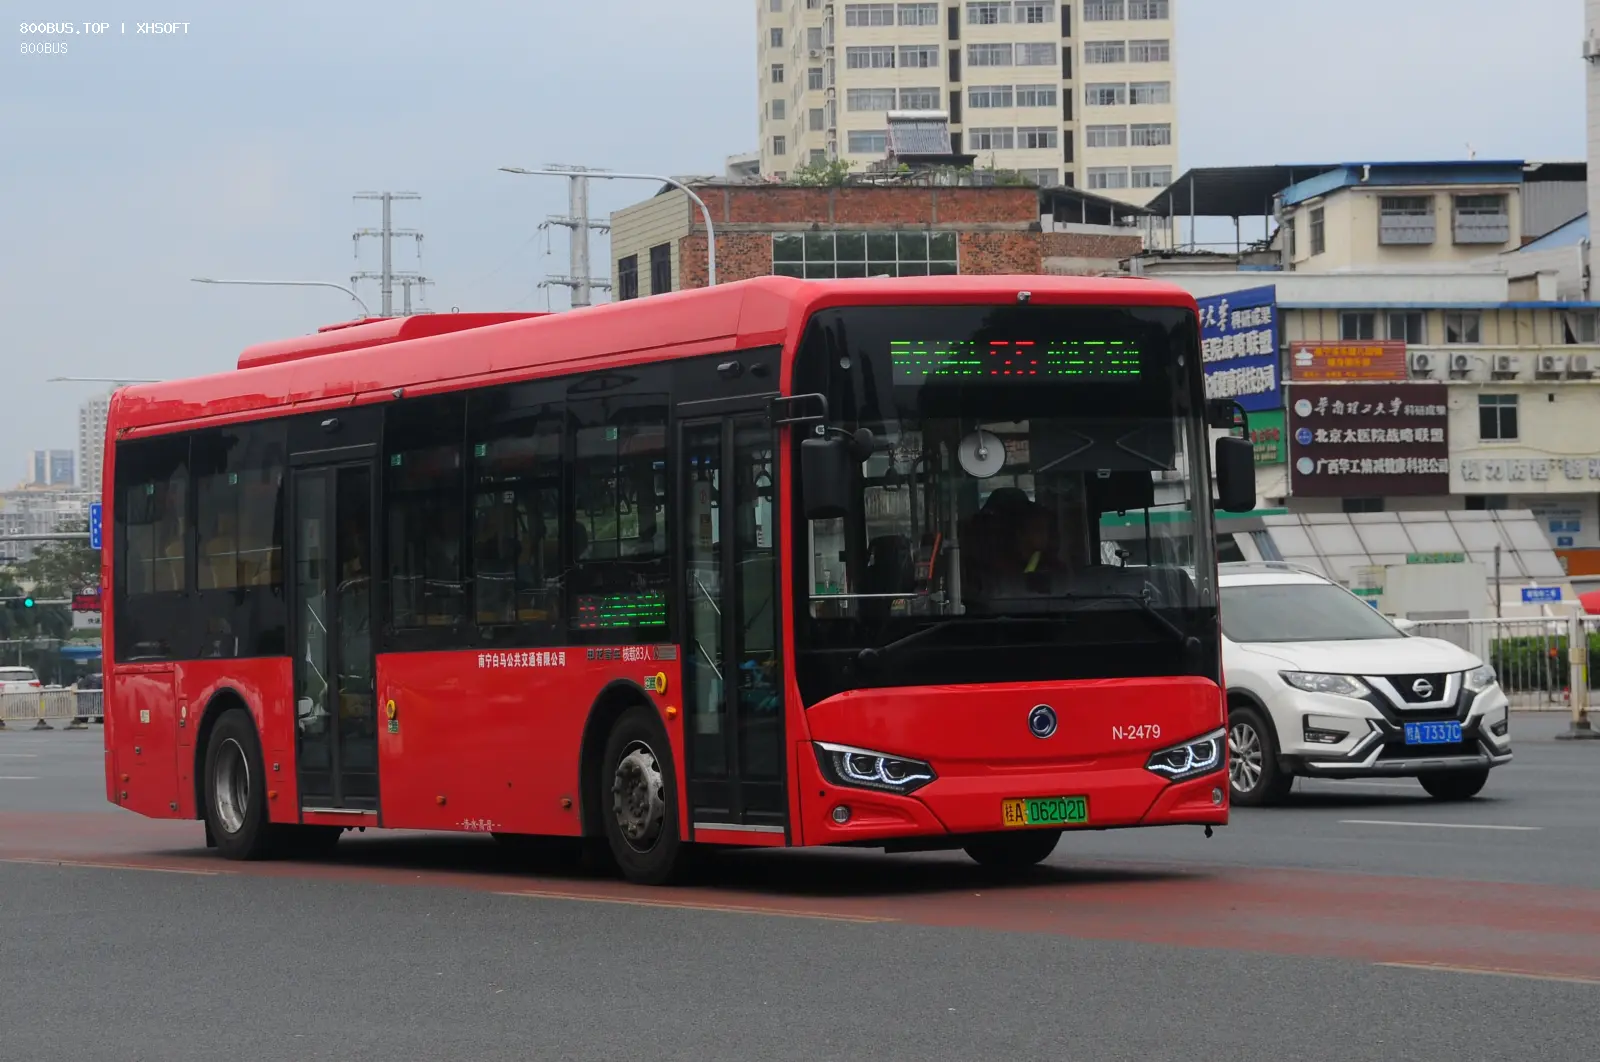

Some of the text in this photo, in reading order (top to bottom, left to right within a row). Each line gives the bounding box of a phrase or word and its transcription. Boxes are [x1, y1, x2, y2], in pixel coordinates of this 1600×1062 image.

[478, 651, 566, 669] 南宁白马公共交通有限公司
[1112, 724, 1161, 740] N-2479
